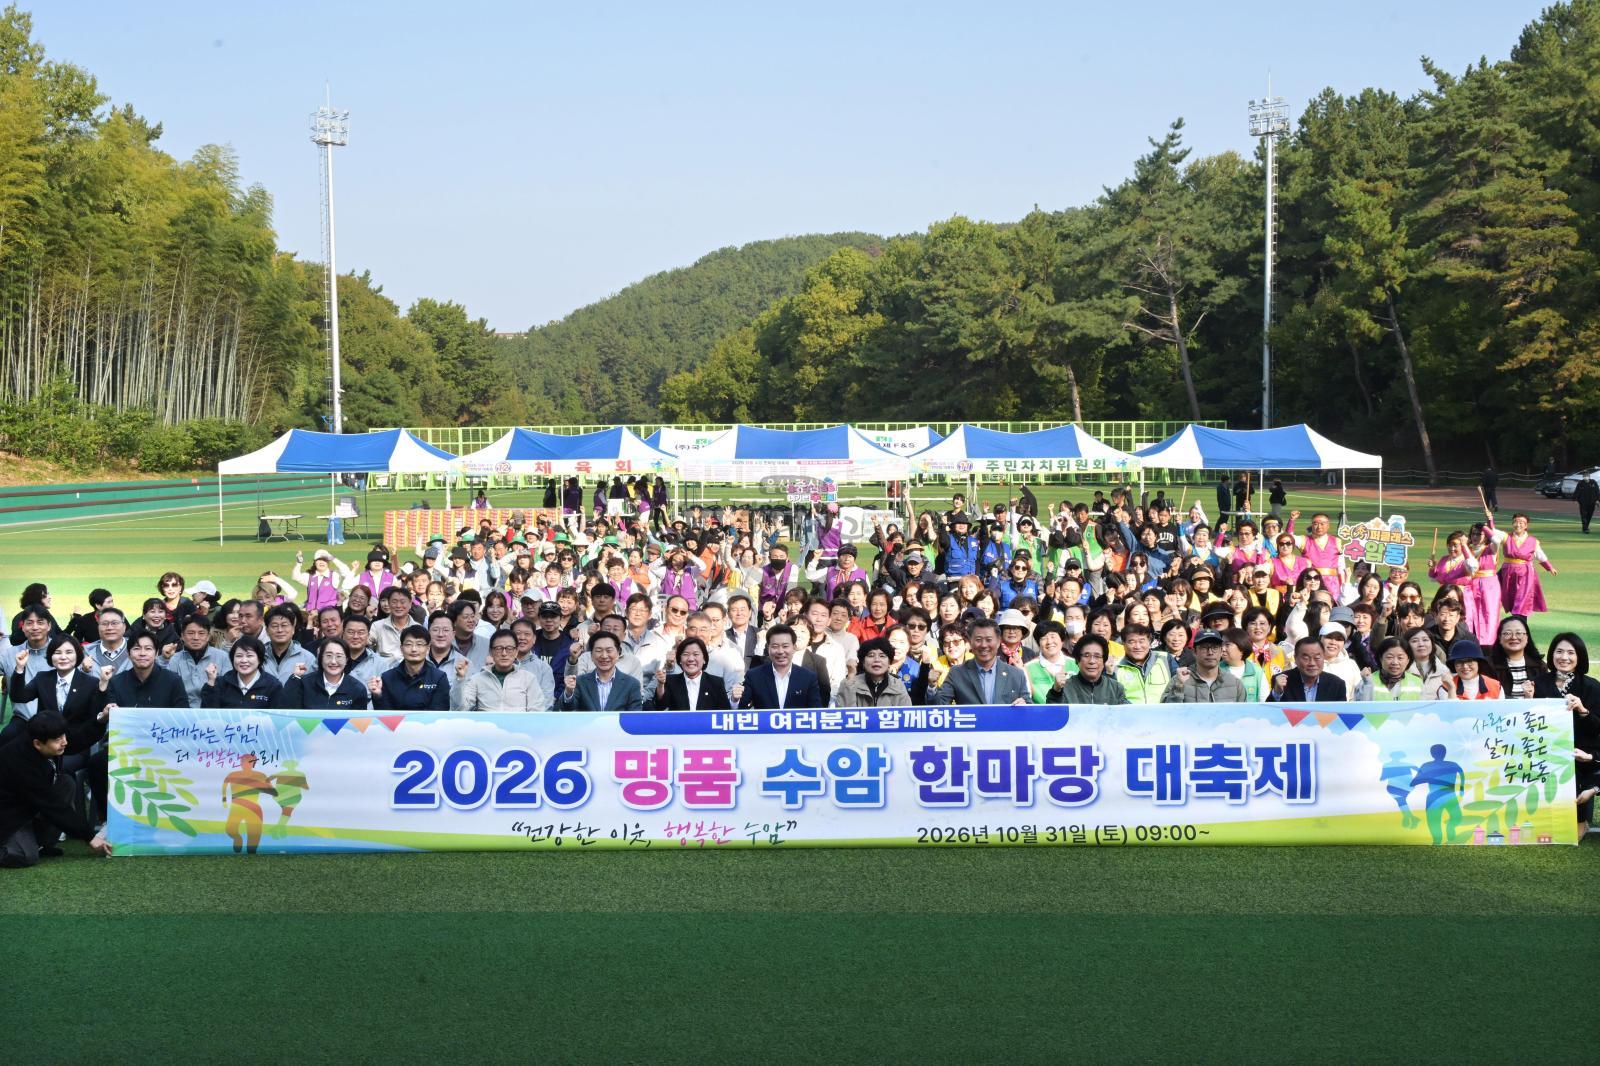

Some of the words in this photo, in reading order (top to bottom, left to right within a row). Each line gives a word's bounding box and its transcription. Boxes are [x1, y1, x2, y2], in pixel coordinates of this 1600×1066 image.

[986, 458, 1106, 472] 주민자치위원회
[1344, 539, 1406, 565] 수암동
[711, 711, 759, 731] 내빈
[769, 710, 869, 731] 여러분과
[879, 708, 977, 730] 함께하는
[1472, 712, 1516, 734] 사람이
[1523, 711, 1549, 733] 좋고
[150, 723, 220, 744] 함께하는
[223, 723, 259, 743] 수암!
[175, 750, 190, 764] 더
[197, 749, 243, 768] 행복한
[248, 749, 280, 768] 우리!
[1484, 737, 1515, 760] 살기
[1521, 736, 1548, 758] 좋은
[392, 748, 589, 806] 2026
[613, 747, 737, 806] 명품
[762, 746, 888, 805] 수암
[909, 744, 1100, 804] 한마당
[1125, 742, 1312, 802] 대축제
[1503, 760, 1550, 784] 수암동
[610, 822, 652, 847] 이웃,
[663, 820, 736, 847] 행복한
[916, 825, 989, 845] 2026년
[996, 824, 1038, 844] 10월
[1045, 824, 1087, 844] 31일
[1094, 824, 1128, 846] (토)
[1135, 824, 1210, 842] 09:00~
